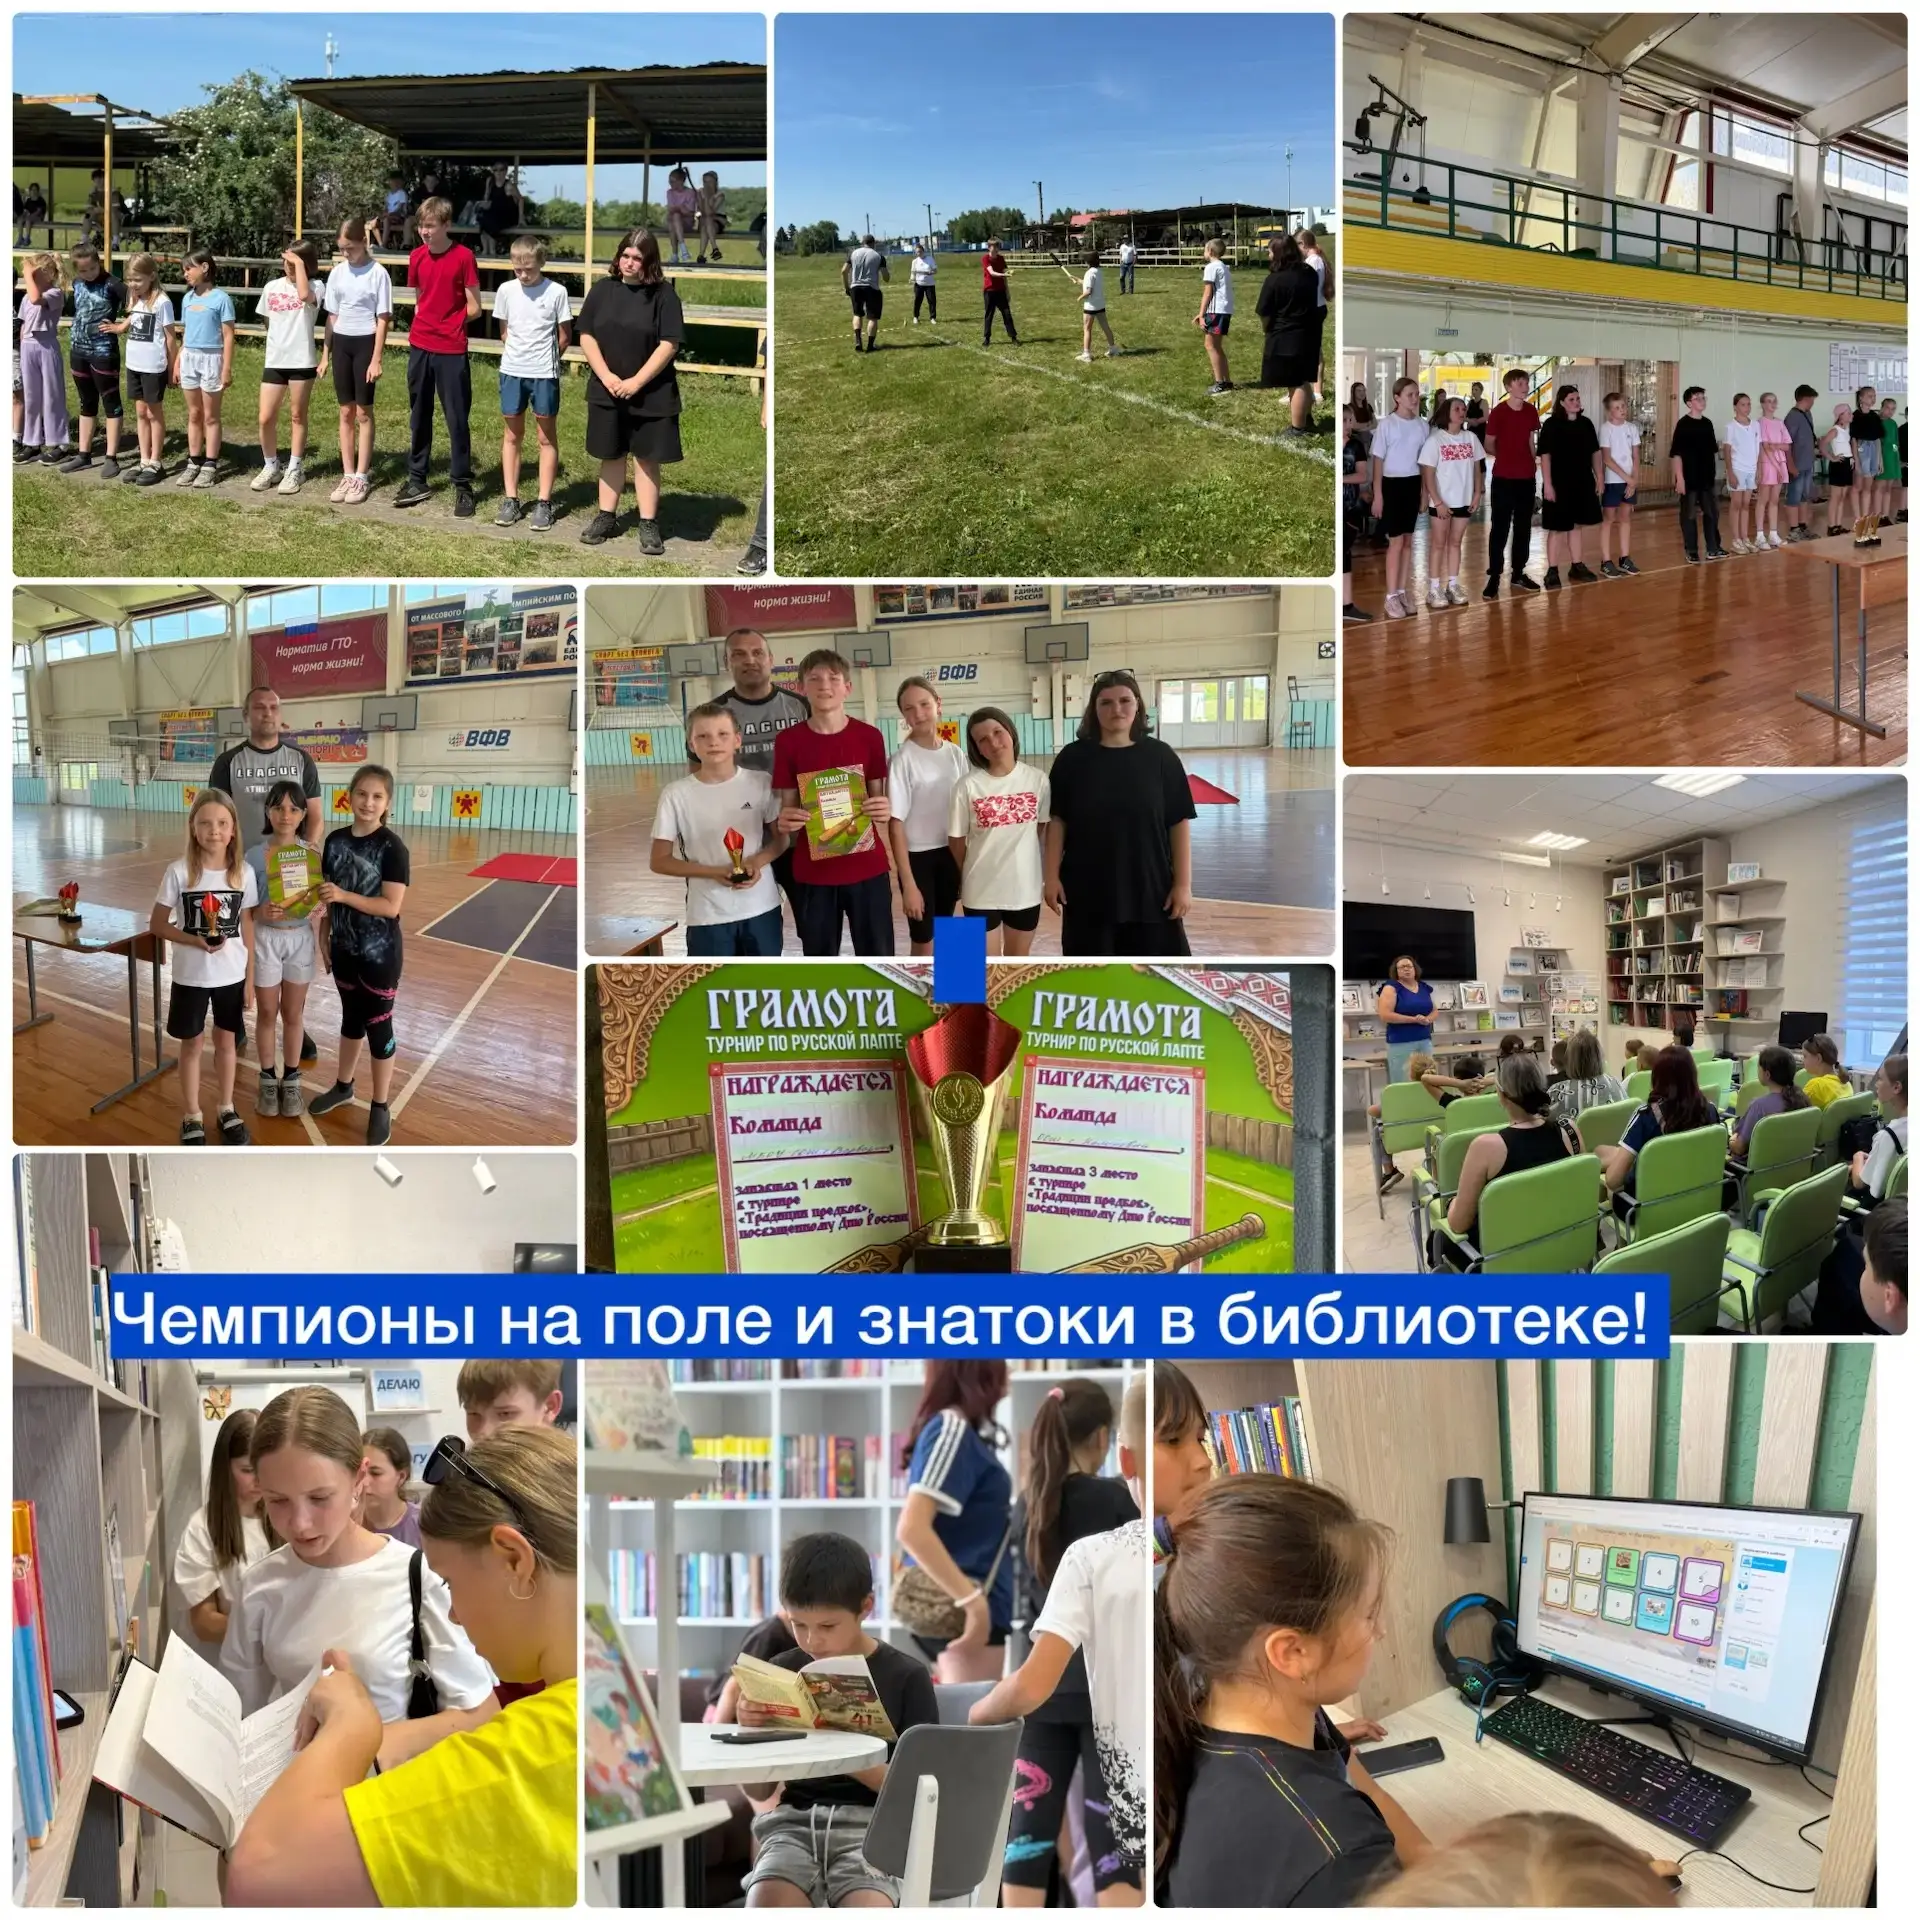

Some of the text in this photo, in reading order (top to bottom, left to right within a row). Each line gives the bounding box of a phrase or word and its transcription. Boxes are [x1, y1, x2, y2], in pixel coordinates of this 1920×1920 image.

[563, 591, 578, 600] ПО
[753, 590, 831, 610] норма жизни!
[1014, 587, 1044, 595] ЕДИНАЯ
[1014, 594, 1044, 602] РОССИЯ
[410, 615, 420, 623] ОТ
[420, 609, 461, 621] МАССОВОГО
[275, 641, 328, 659] Норматив
[330, 636, 352, 651] ГТО
[291, 655, 365, 675] норма жизни!
[938, 663, 978, 681] ВФВ
[744, 717, 799, 735] AGUE
[465, 729, 511, 747] ВФВ
[236, 765, 299, 779] LEAGUE
[814, 773, 849, 786] ГРАМОТА
[706, 988, 899, 1030] ГРАМОТА
[1031, 990, 1202, 1040] ГРАМОТА
[705, 1030, 904, 1053] ТУРНИР ПО РУССКОЙ ЛАПТЕ
[1026, 1031, 1206, 1060] ТУРНИР ПО РУССКОЙ ЛАПТЕ
[726, 1071, 894, 1097] НАГРАЖДАЕТСЯ
[1037, 1068, 1191, 1095] НАГРАЖДАЕТСЯ
[1034, 1102, 1117, 1126] Команда
[729, 1115, 823, 1135] Команда
[1089, 1166, 1097, 1177] 3
[1100, 1168, 1139, 1181] место
[802, 1178, 809, 1190] 1
[813, 1176, 852, 1189] место
[1038, 1177, 1086, 1192] турнире
[747, 1195, 801, 1212] турнире
[1027, 1188, 1154, 1210] «Традиции предков»,
[738, 1203, 873, 1226] «Традиции предков»,
[1026, 1203, 1193, 1227] посвященному Дню России
[738, 1213, 910, 1239] посвященному Дню России
[377, 1378, 420, 1392] ДЕЛАЮ
[413, 1453, 427, 1464] ГУ
[1690, 1618, 1700, 1627] 10
